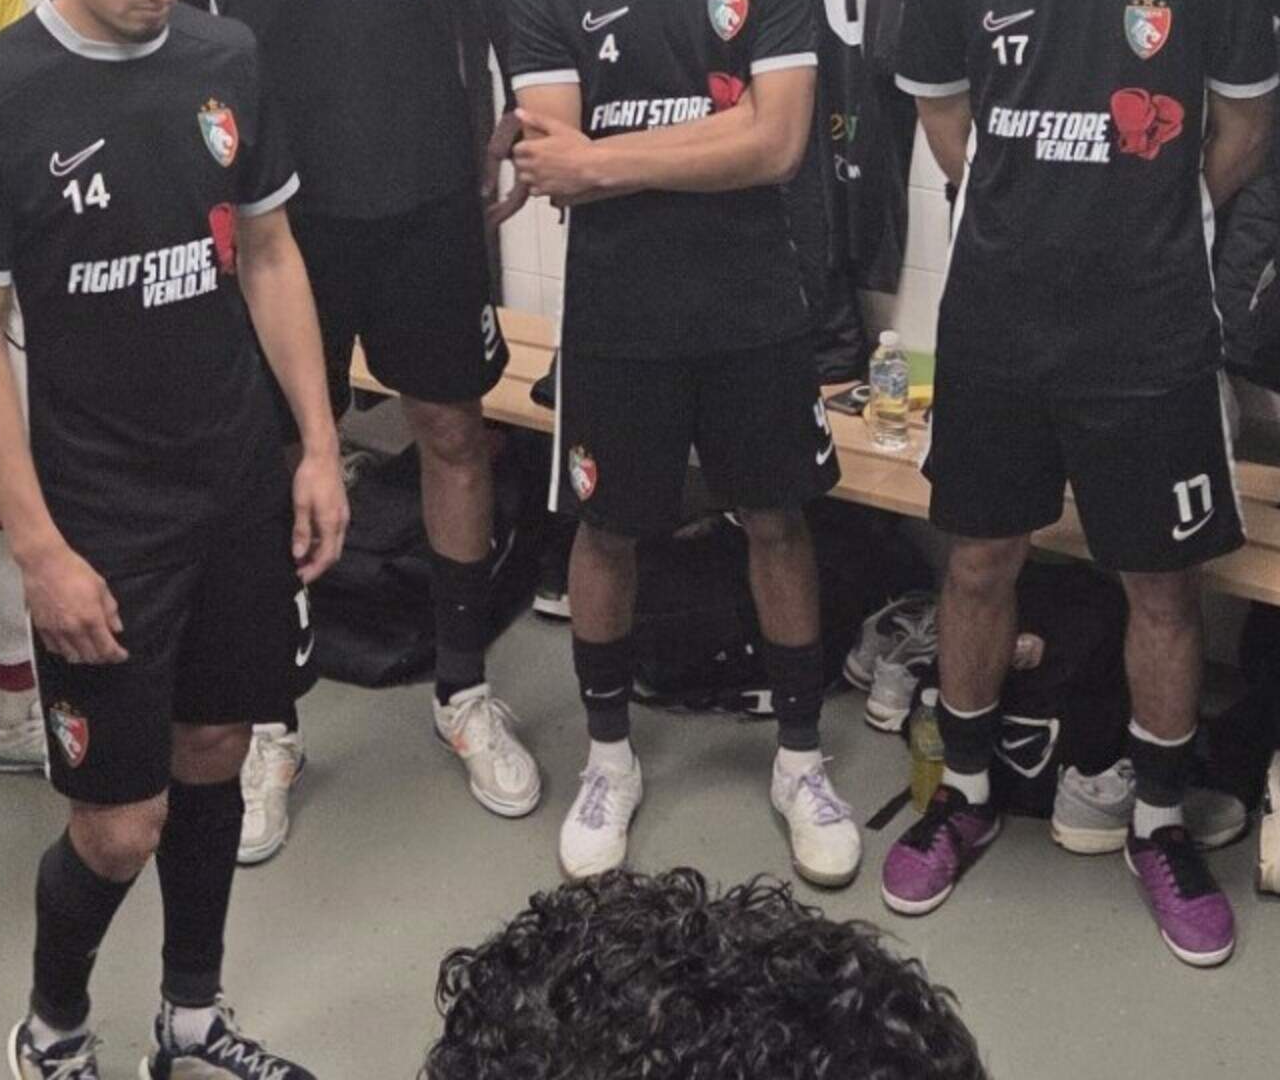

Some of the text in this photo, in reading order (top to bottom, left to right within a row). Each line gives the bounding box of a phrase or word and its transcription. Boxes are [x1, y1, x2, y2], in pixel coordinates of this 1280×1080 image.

[599, 33, 620, 63] 4
[991, 35, 1029, 65] 17
[590, 95, 713, 131] FIGHT STORE
[987, 106, 1111, 141] FIGHT STORE
[1035, 139, 1110, 163] VENLO.NL
[62, 172, 111, 215] 14
[67, 237, 215, 294] FIGHT STORE
[142, 266, 218, 309] VENLO.NL
[1173, 473, 1212, 523] 17
